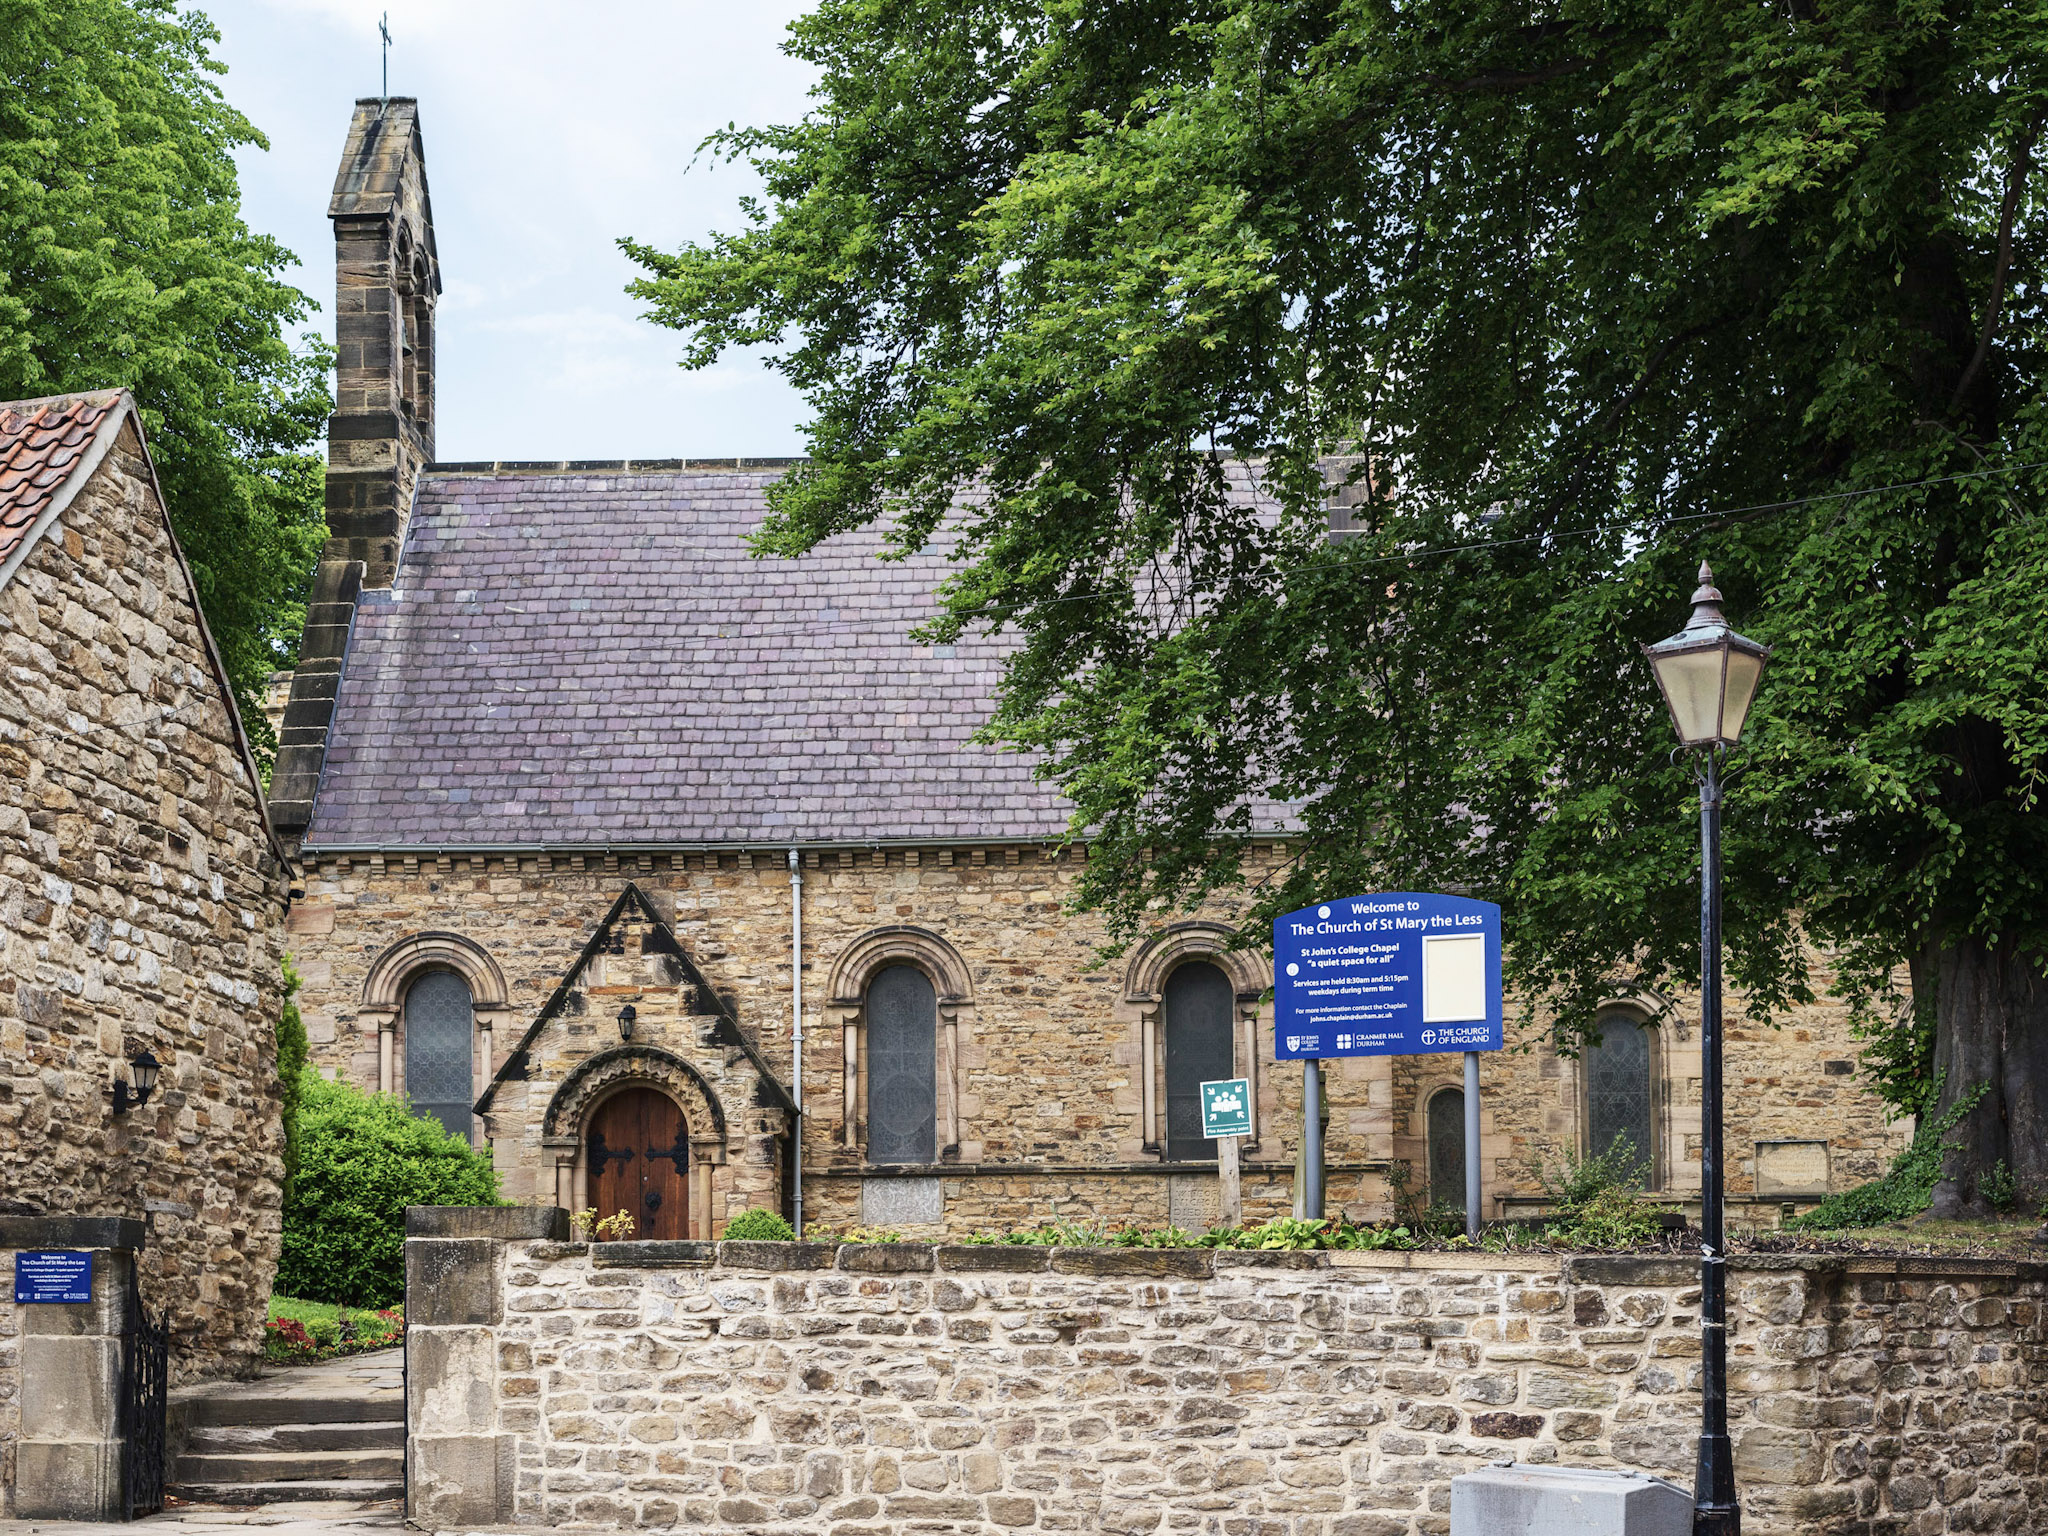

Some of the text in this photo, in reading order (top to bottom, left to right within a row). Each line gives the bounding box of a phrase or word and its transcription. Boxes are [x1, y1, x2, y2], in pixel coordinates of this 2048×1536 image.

[1351, 901, 1420, 914] Welcome to
[1290, 914, 1483, 936] The Church of St Mary the Less
[1301, 943, 1399, 957] St John's College Chapel
[1317, 958, 1339, 968] quiet
[1341, 958, 1364, 967] space
[1366, 955, 1378, 964] for
[1293, 979, 1319, 988] Services
[1331, 977, 1345, 985] held
[1371, 975, 1383, 983] and
[1384, 974, 1408, 983] 5:15pm
[1308, 988, 1339, 996] weekdays
[1340, 986, 1361, 995] during
[1320, 1005, 1351, 1013] information
[1383, 1002, 1408, 1010] Chaplain
[1438, 1027, 1489, 1036] THE CHURCH
[1438, 1035, 1490, 1044] OF ENGLAND
